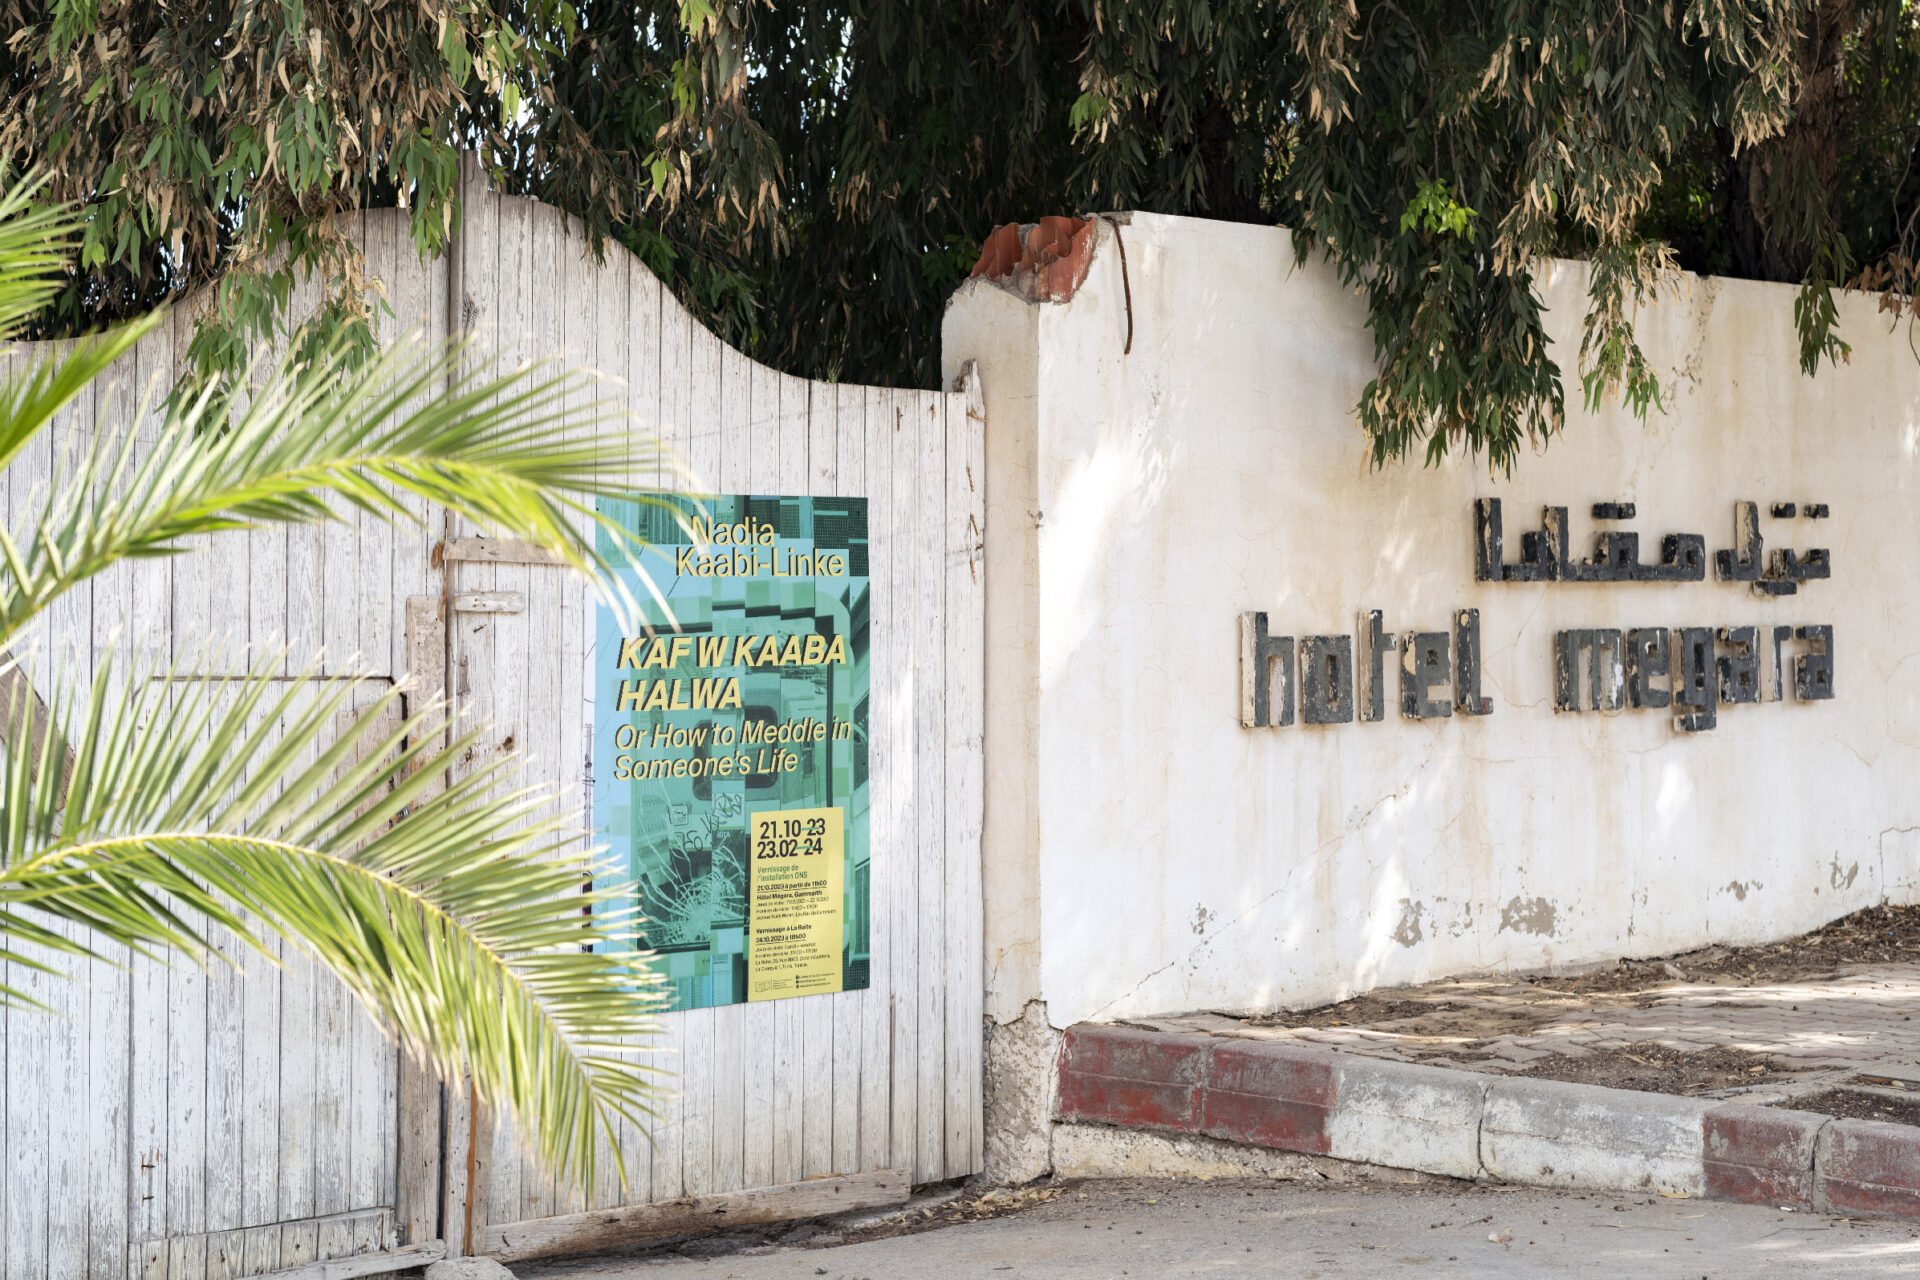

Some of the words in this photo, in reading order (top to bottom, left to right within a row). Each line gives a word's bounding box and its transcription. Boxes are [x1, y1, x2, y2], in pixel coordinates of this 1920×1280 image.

[691, 515, 775, 546] Nadia
[676, 546, 845, 577] Kaabi-Linke
[616, 636, 693, 670] KAF
[696, 636, 730, 667] W
[731, 634, 847, 667] KAABA
[1240, 608, 1494, 728] hotel
[1555, 625, 1835, 732] megara
[616, 677, 743, 712] HALWA
[615, 725, 648, 750] Or
[651, 722, 708, 749] How
[711, 723, 735, 746] to
[740, 718, 827, 746] Meddle
[831, 717, 852, 741] in
[756, 748, 799, 775] Life
